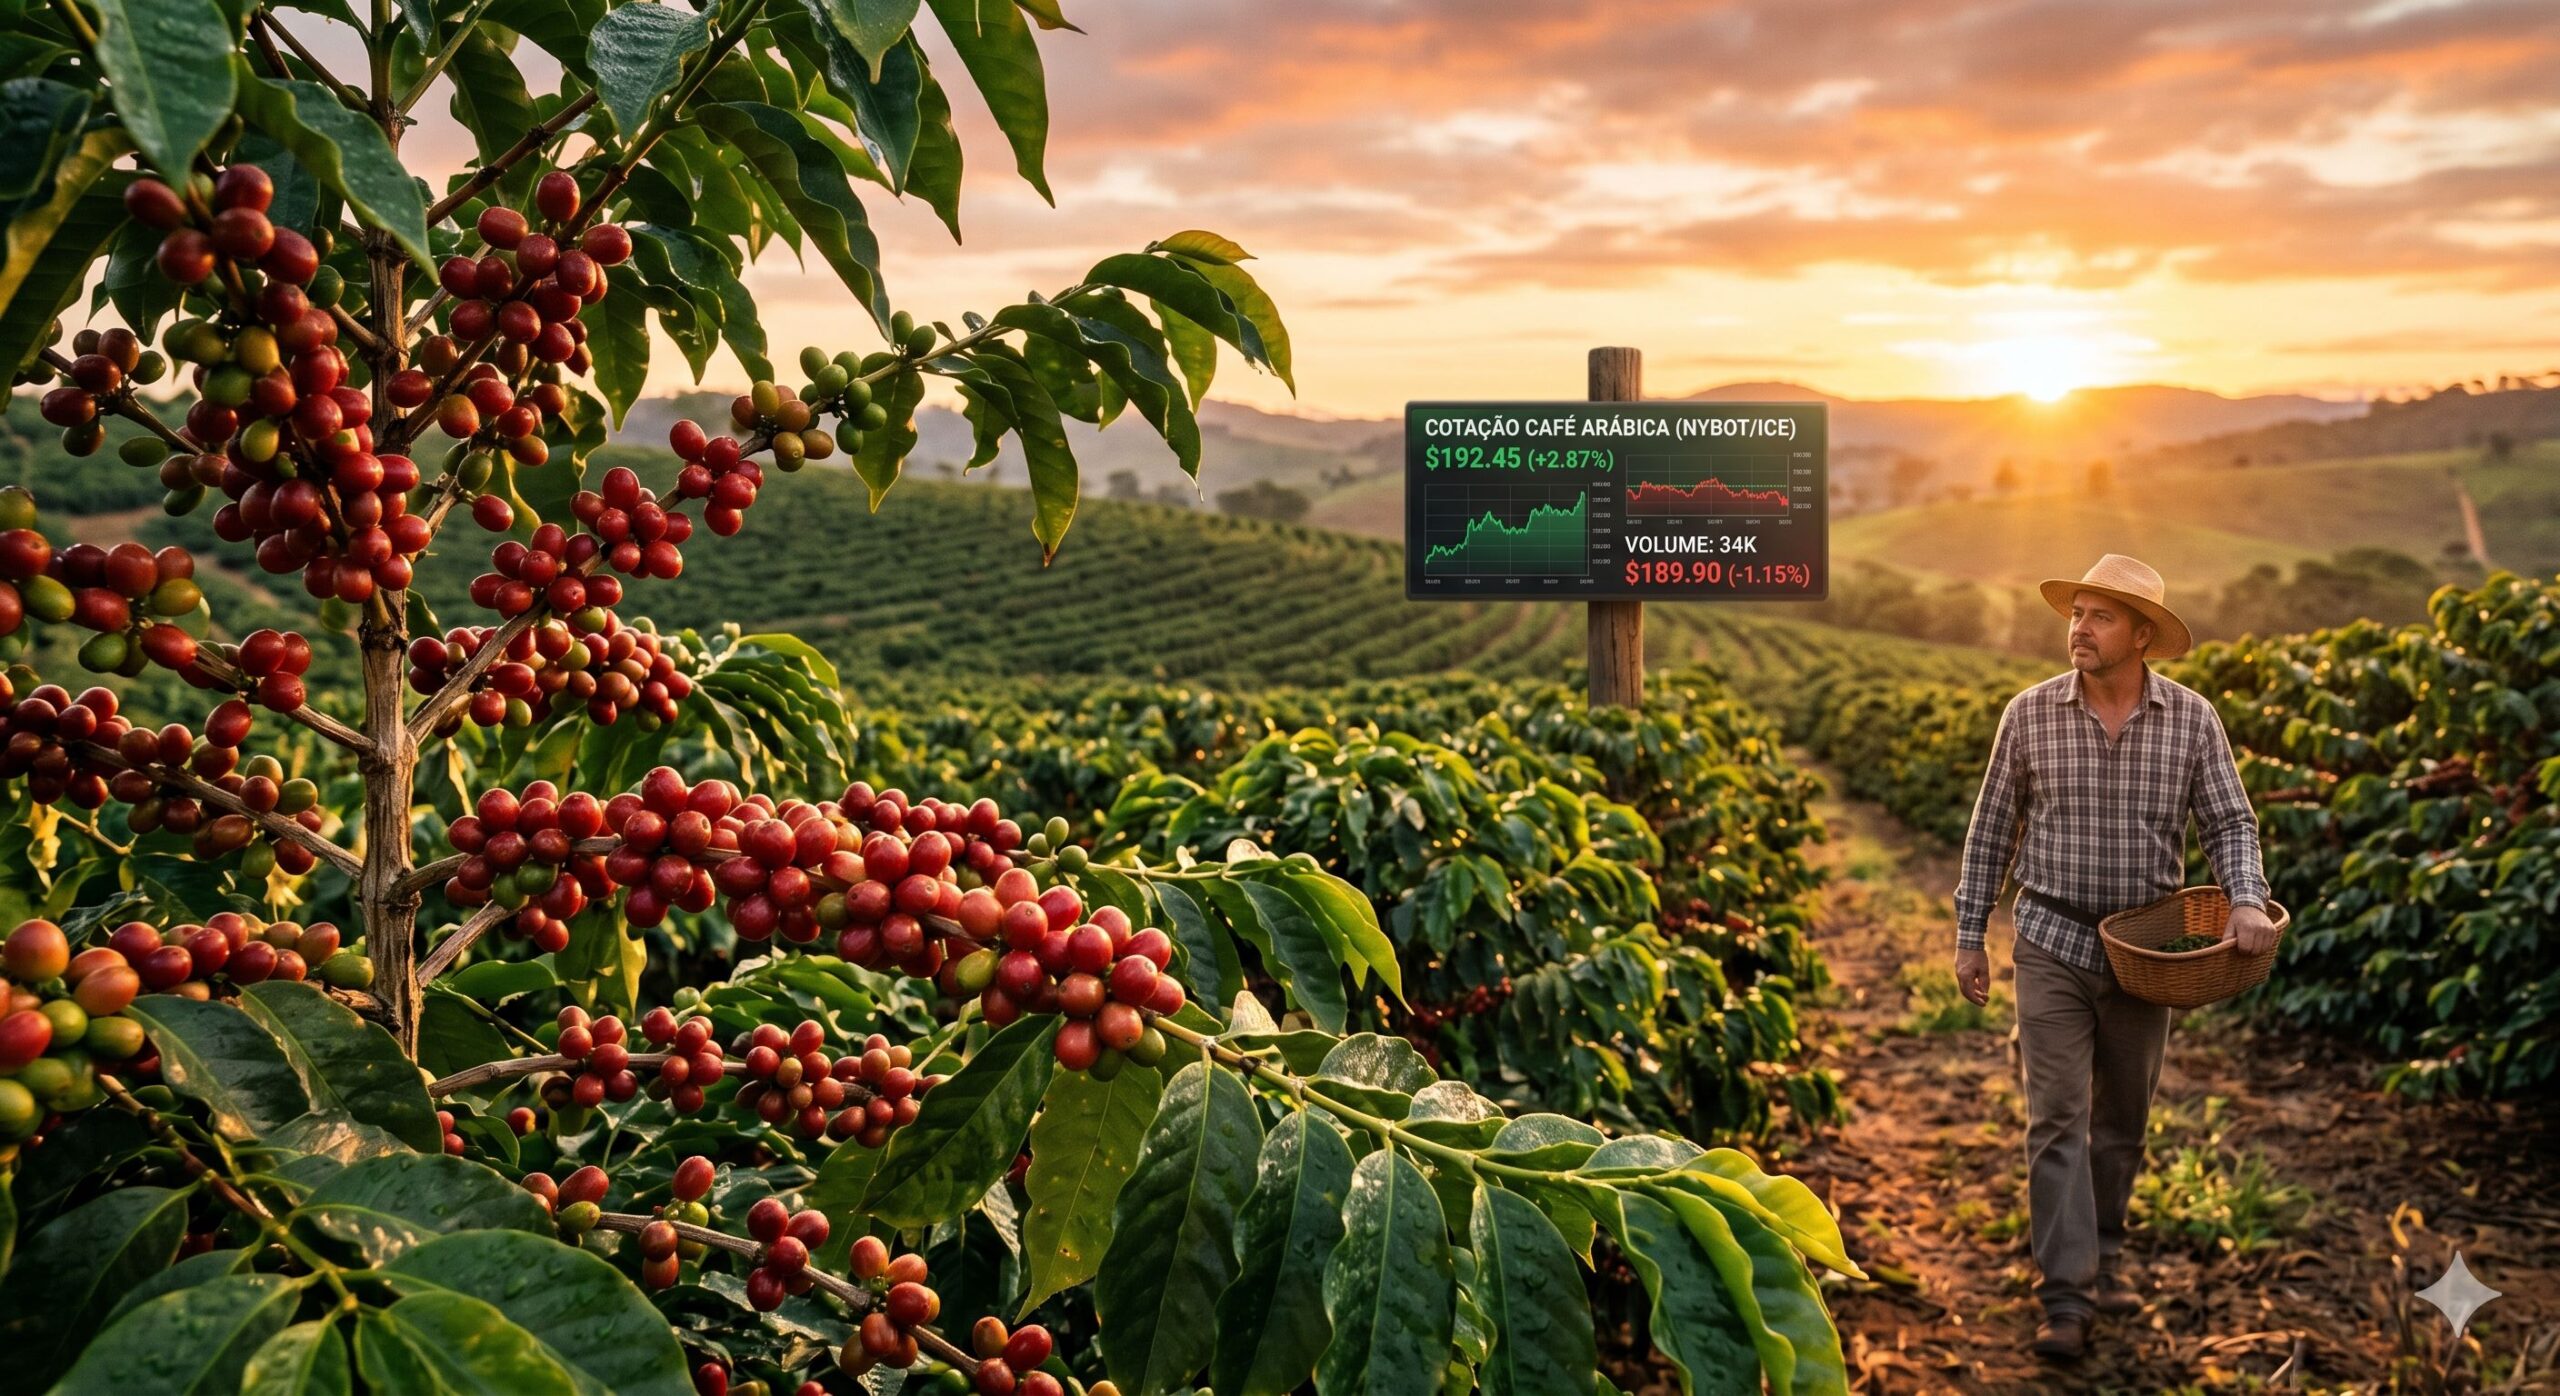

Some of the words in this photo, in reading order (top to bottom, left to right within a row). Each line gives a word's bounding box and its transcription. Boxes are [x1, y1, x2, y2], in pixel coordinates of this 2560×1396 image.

[1425, 415, 1520, 440] COTAÇÃO
[1525, 414, 1576, 437] CAFÉ
[1581, 414, 1670, 437] ARÁBICA
[1676, 417, 1797, 440] (NYBOT/ICE)
[1425, 445, 1521, 470] $192.45
[1528, 449, 1614, 472] (+2.87%)
[1625, 535, 1714, 554] VOLUME:
[1719, 535, 1757, 554] 34K
[1625, 560, 1722, 586] $189.90
[1728, 564, 1810, 588] (-1.15%)
